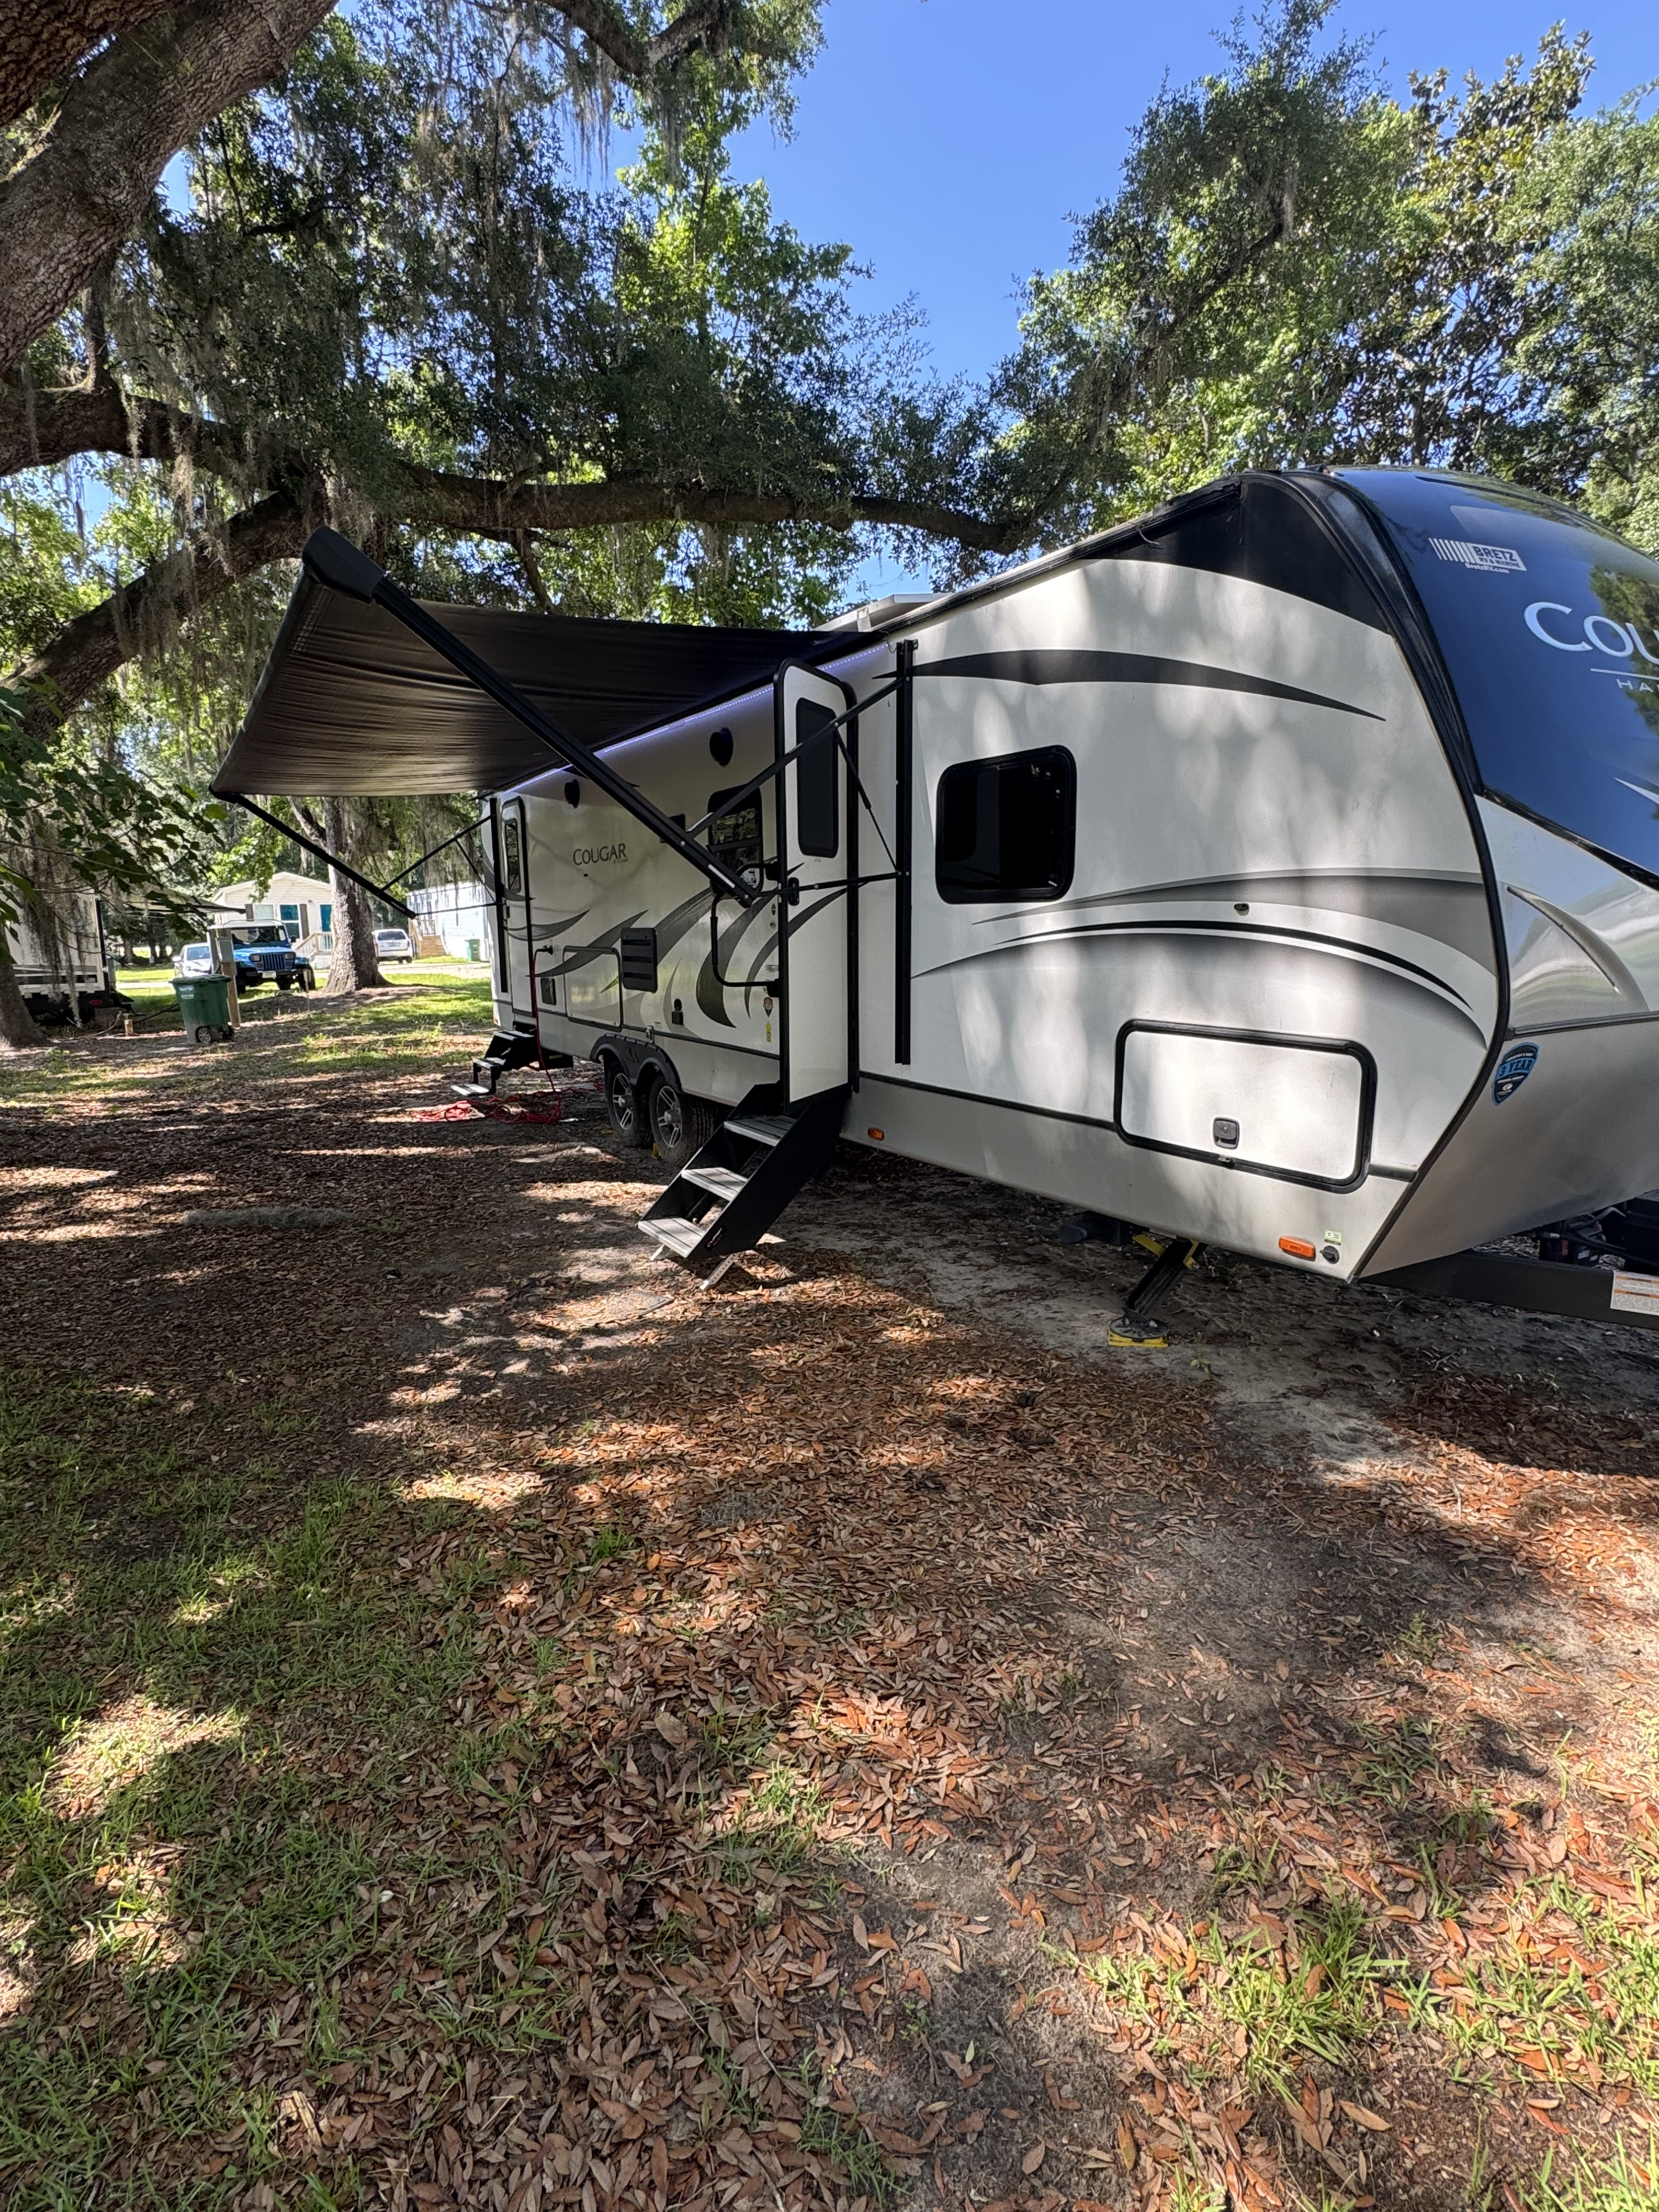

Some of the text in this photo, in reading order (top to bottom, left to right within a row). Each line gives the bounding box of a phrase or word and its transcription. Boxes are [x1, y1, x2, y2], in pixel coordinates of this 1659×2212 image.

[1472, 545, 1517, 562] BRETZ
[573, 843, 628, 865] COUGAR
[1508, 1059, 1533, 1073] YEAR
